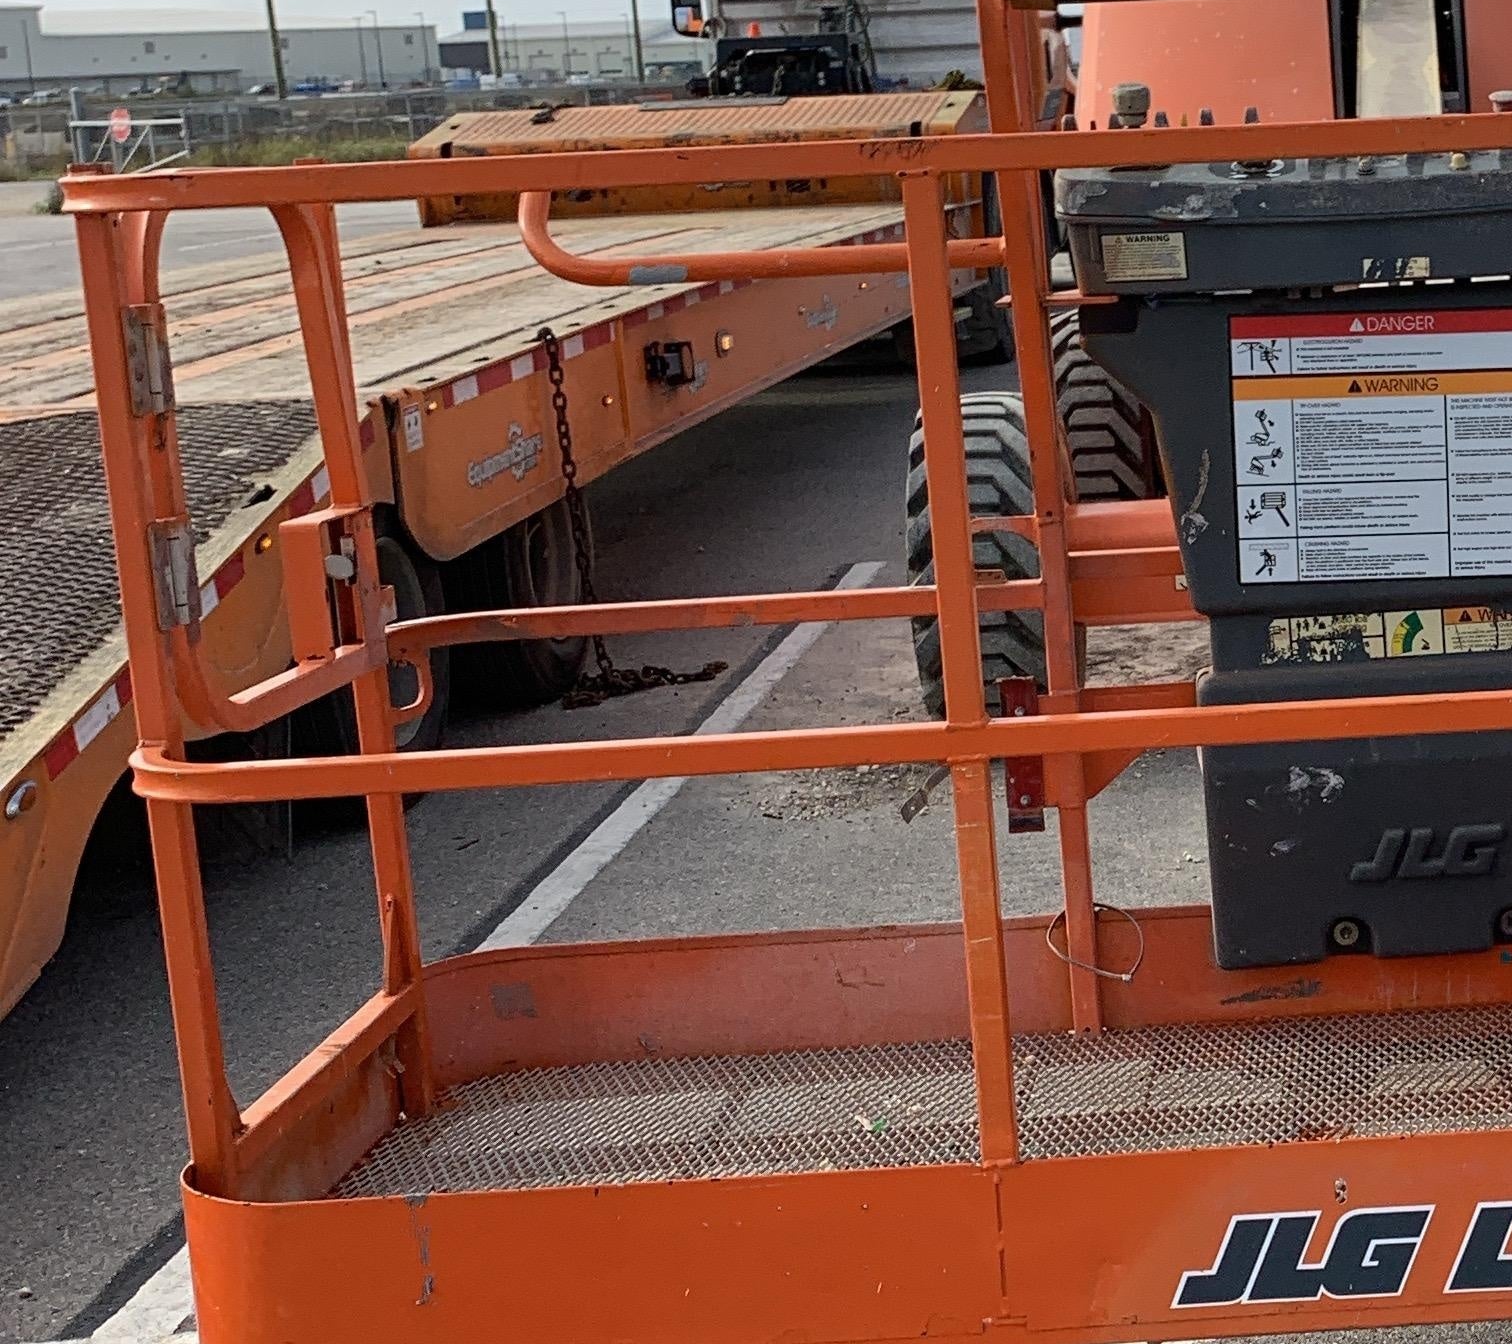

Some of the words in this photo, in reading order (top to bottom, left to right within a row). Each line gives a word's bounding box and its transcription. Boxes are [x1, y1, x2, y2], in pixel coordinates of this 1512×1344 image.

[1126, 234, 1170, 243] WARNING
[1366, 315, 1435, 332] DANGER
[1365, 377, 1439, 393] WARNING
[1349, 822, 1506, 882] JLG
[1170, 1204, 1435, 1309] JLG
